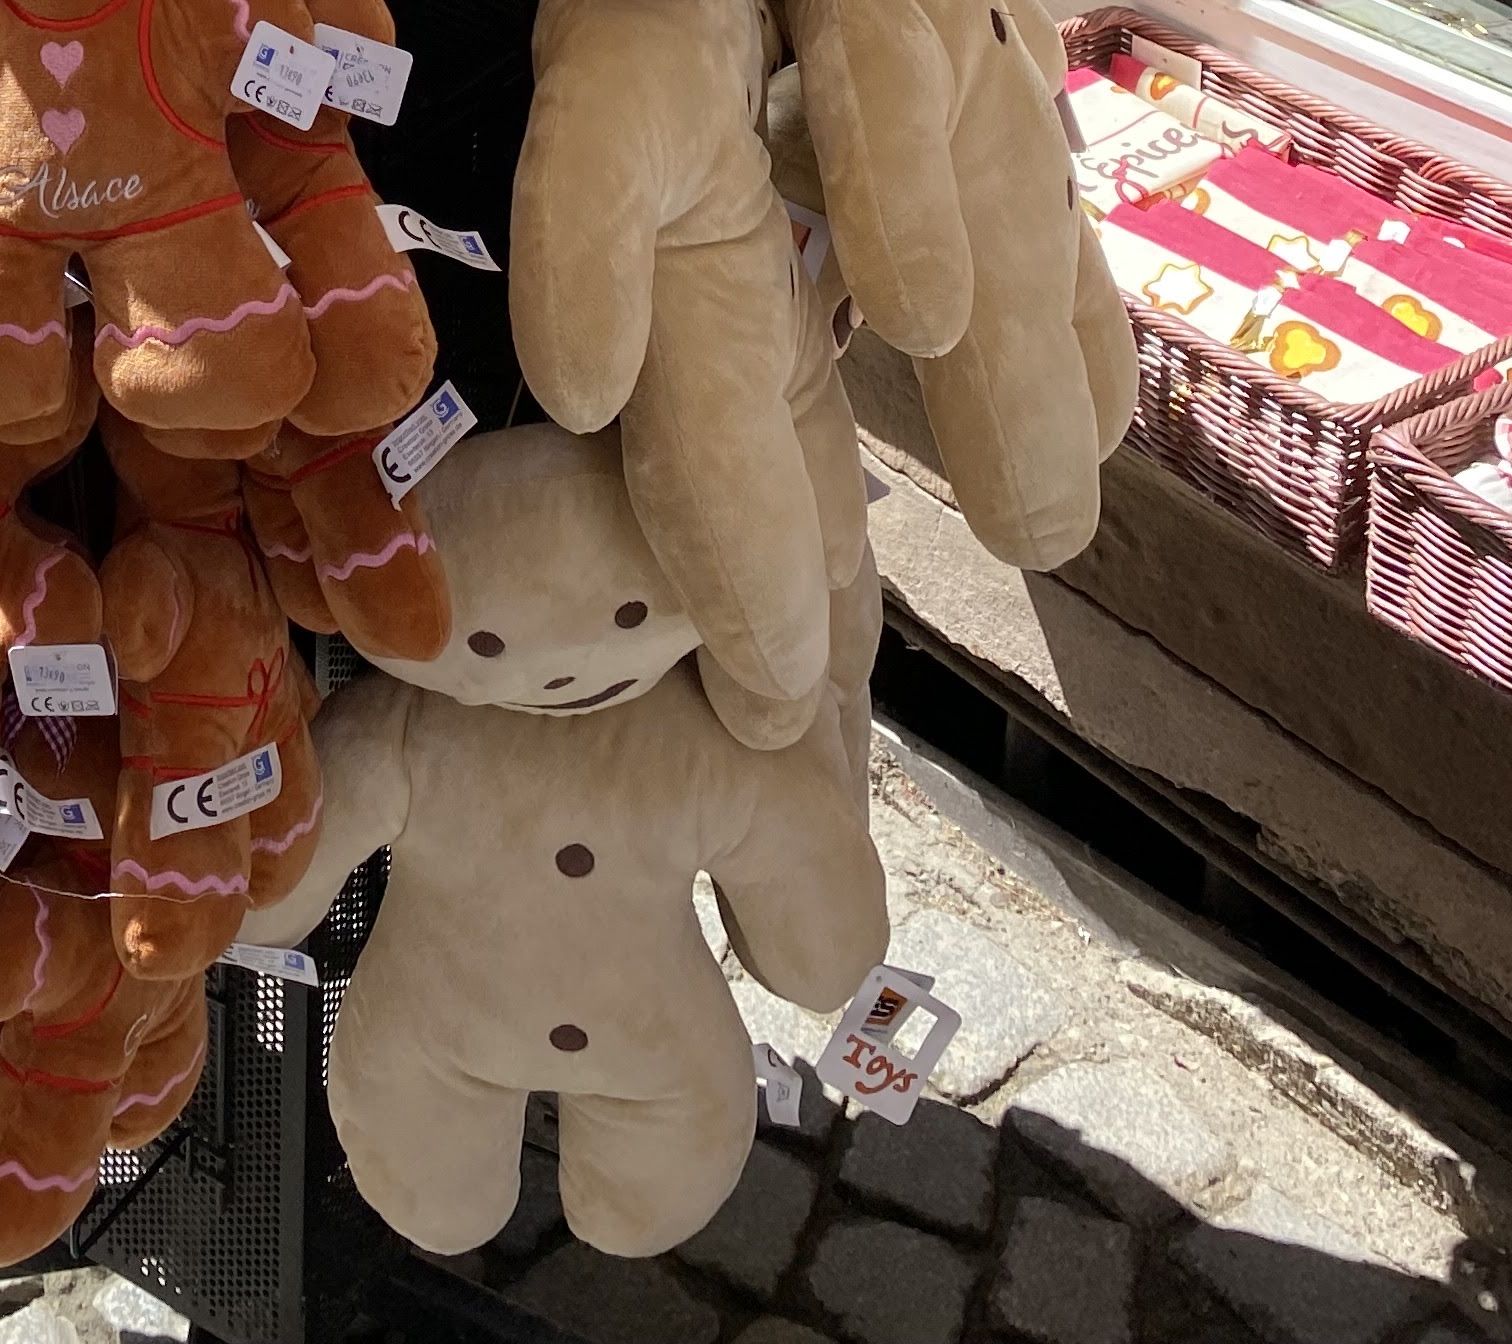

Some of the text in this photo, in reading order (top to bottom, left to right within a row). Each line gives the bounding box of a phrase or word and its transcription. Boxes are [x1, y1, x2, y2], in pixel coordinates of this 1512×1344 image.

[244, 80, 267, 103] CE
[398, 210, 441, 249] CE
[31, 696, 55, 713] CE
[166, 777, 218, 824] CE
[842, 1033, 919, 1095] Toys
